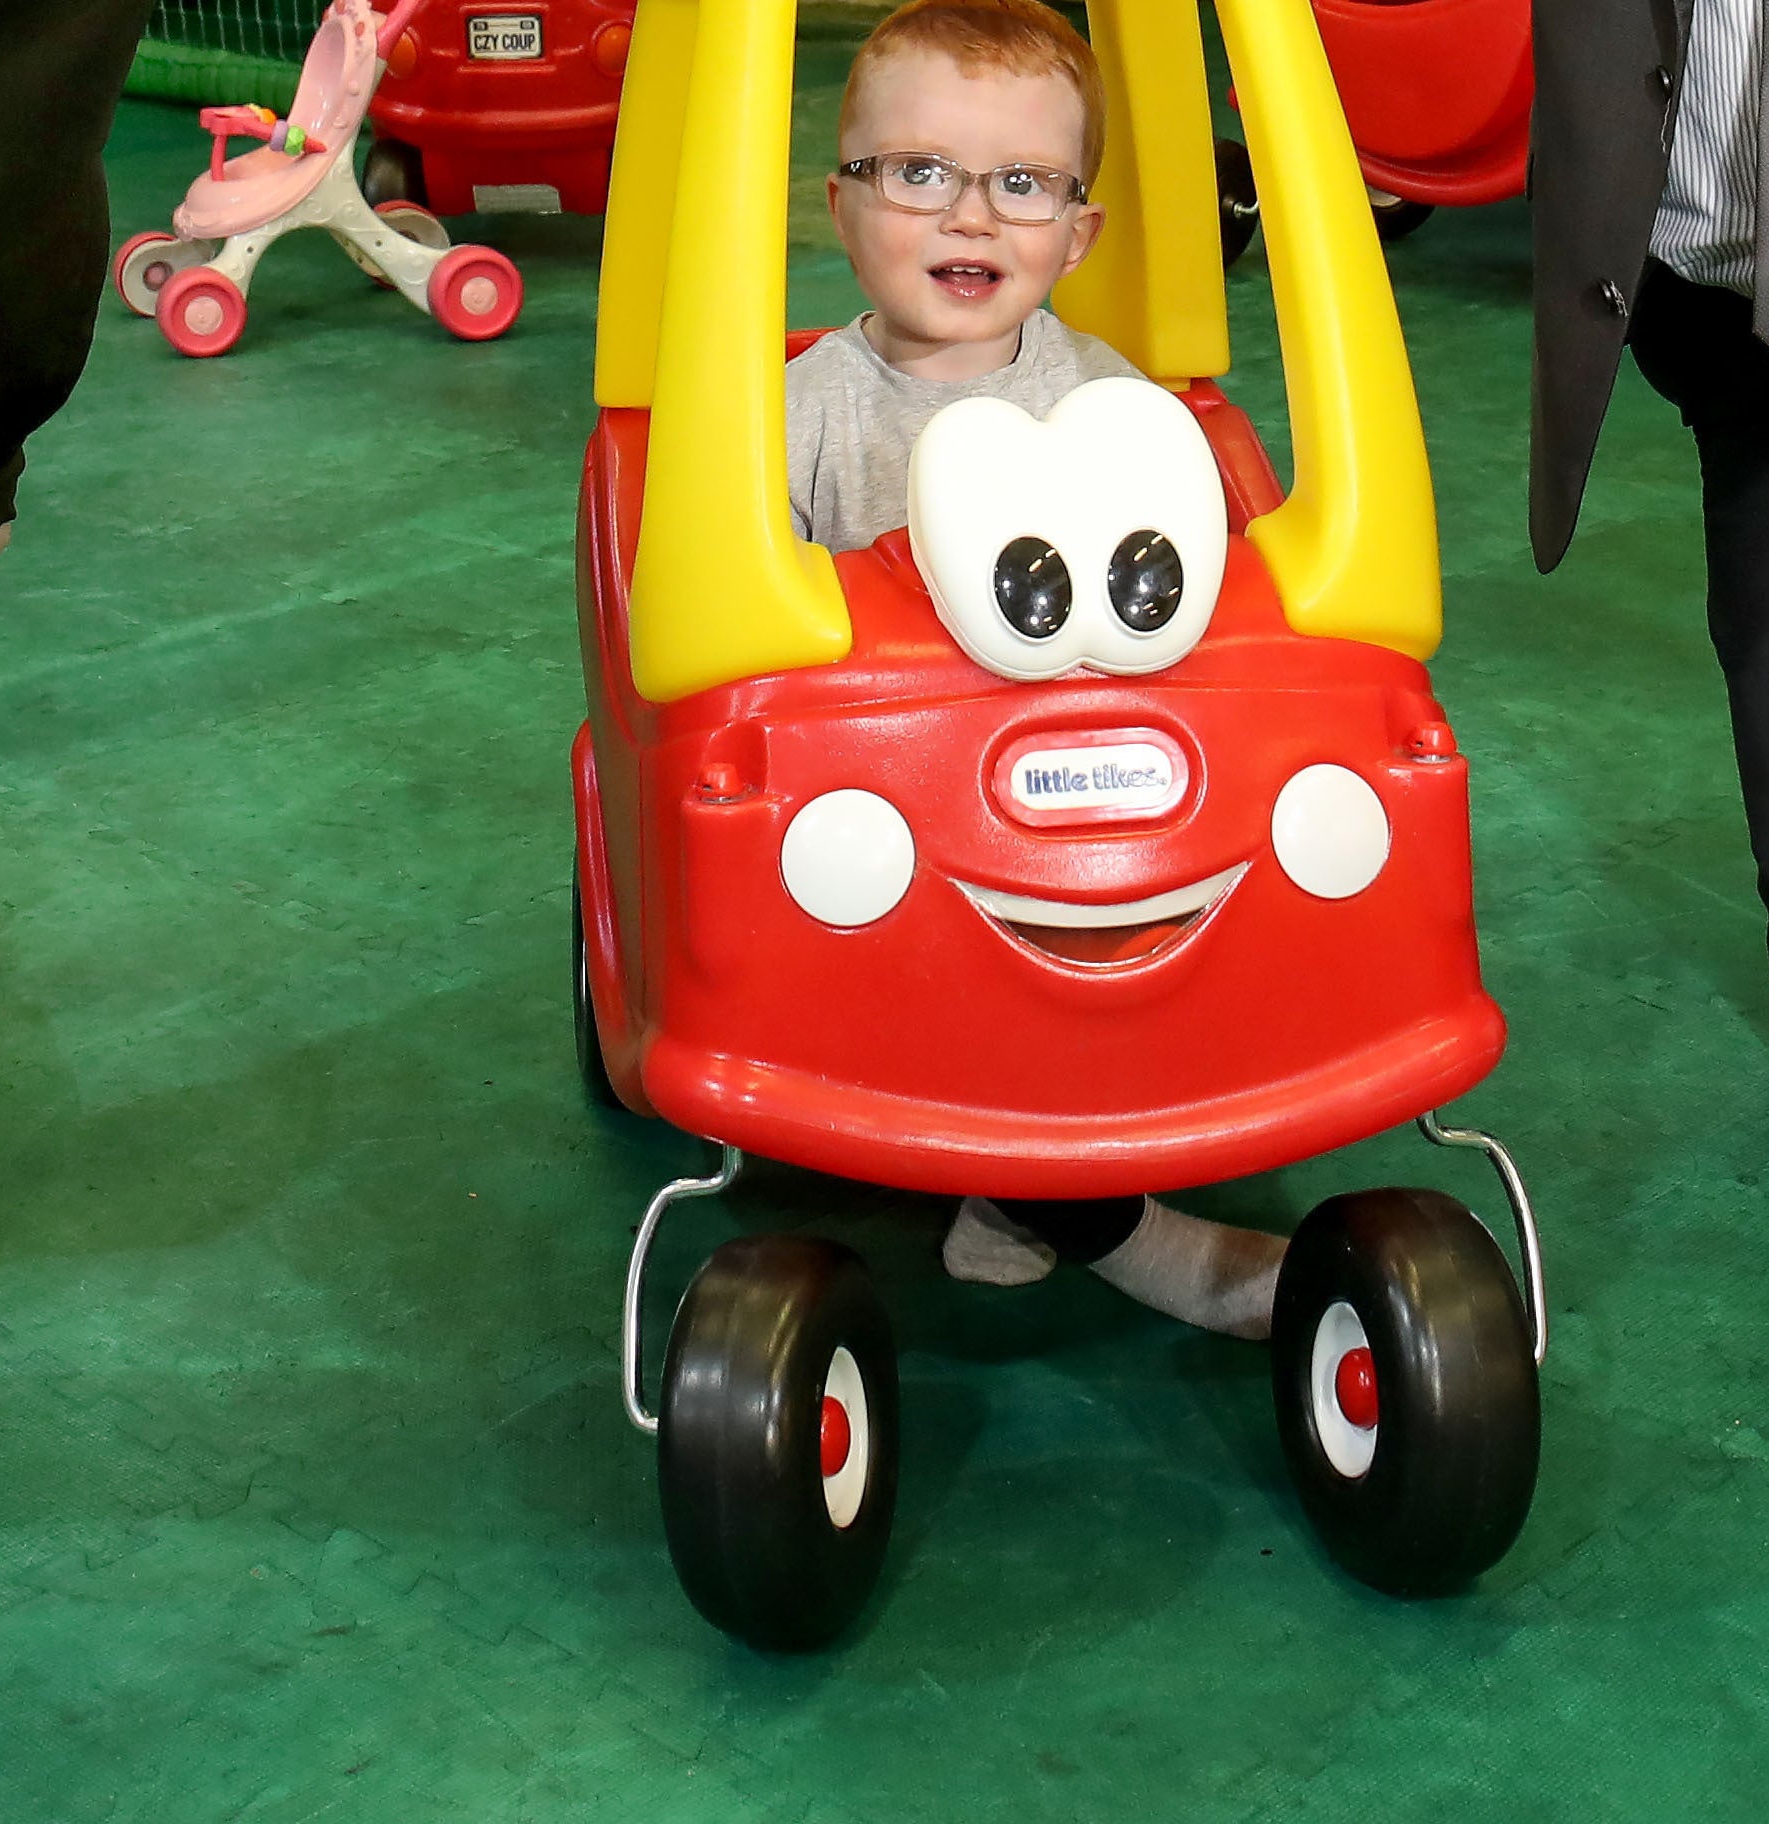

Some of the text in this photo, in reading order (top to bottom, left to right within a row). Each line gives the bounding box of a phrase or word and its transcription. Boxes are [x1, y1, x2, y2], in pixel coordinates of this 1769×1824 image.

[474, 33, 536, 50] CZY COUP
[1025, 766, 1088, 795] little
